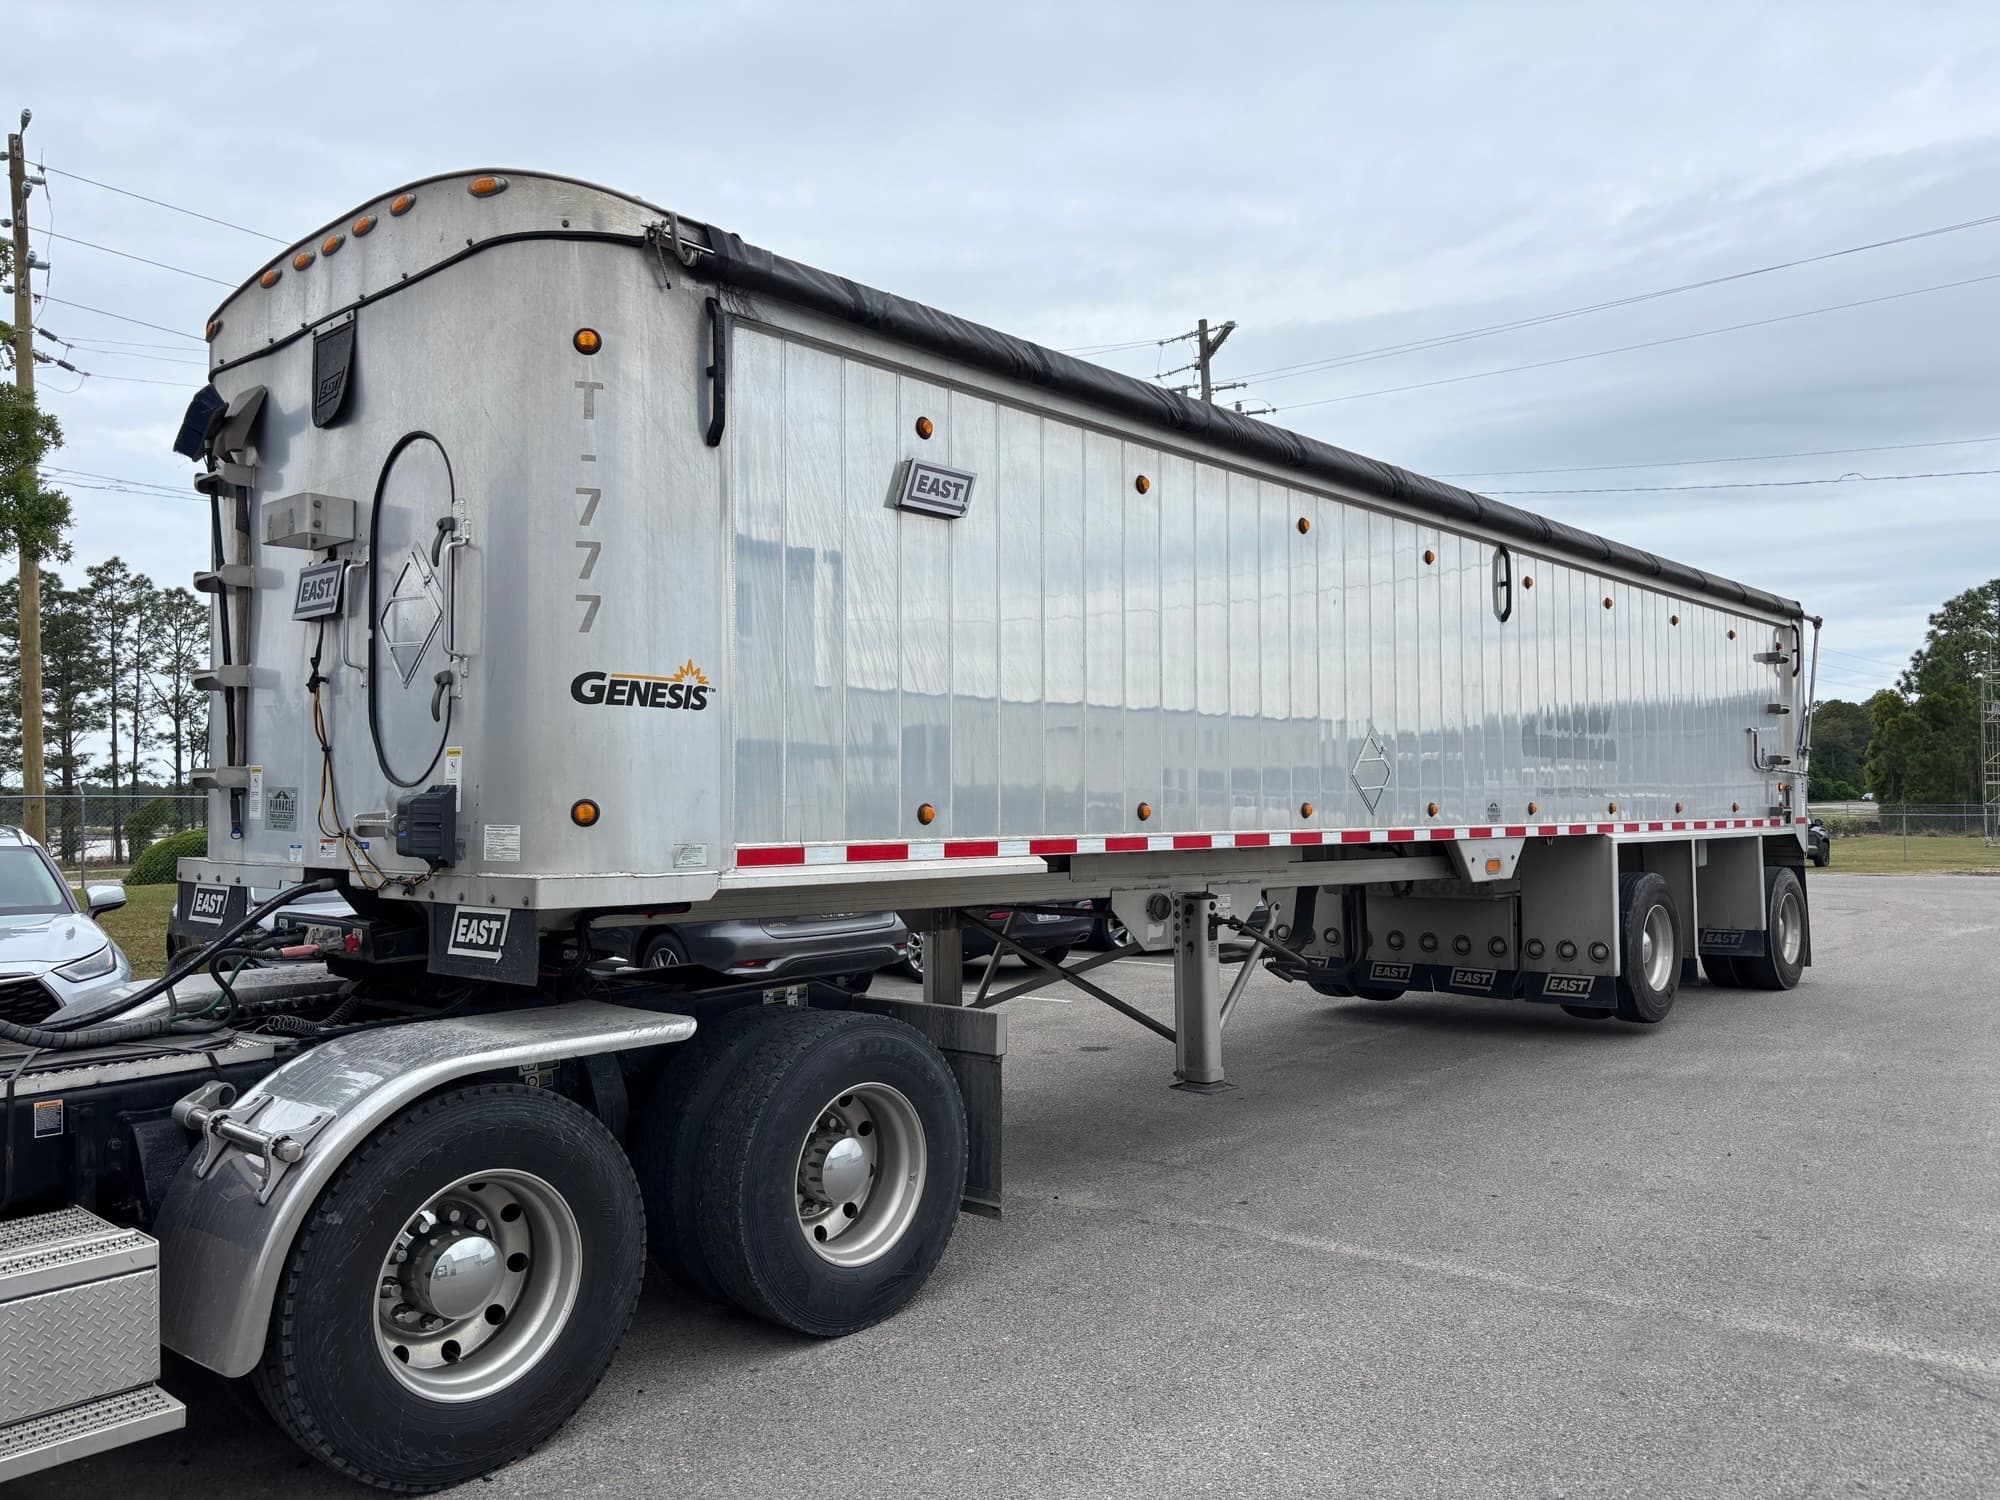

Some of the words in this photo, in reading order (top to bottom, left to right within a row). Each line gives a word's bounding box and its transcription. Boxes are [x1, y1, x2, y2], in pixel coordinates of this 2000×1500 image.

[916, 474, 964, 500] EAST
[301, 576, 334, 602] EAST
[570, 671, 708, 711] GENESIS
[195, 892, 224, 914] EAST
[456, 918, 501, 945] EAST
[1705, 933, 1739, 944] EAST
[1374, 966, 1407, 978] EAST
[1455, 971, 1490, 985] EAST
[1549, 979, 1587, 992] EAST
